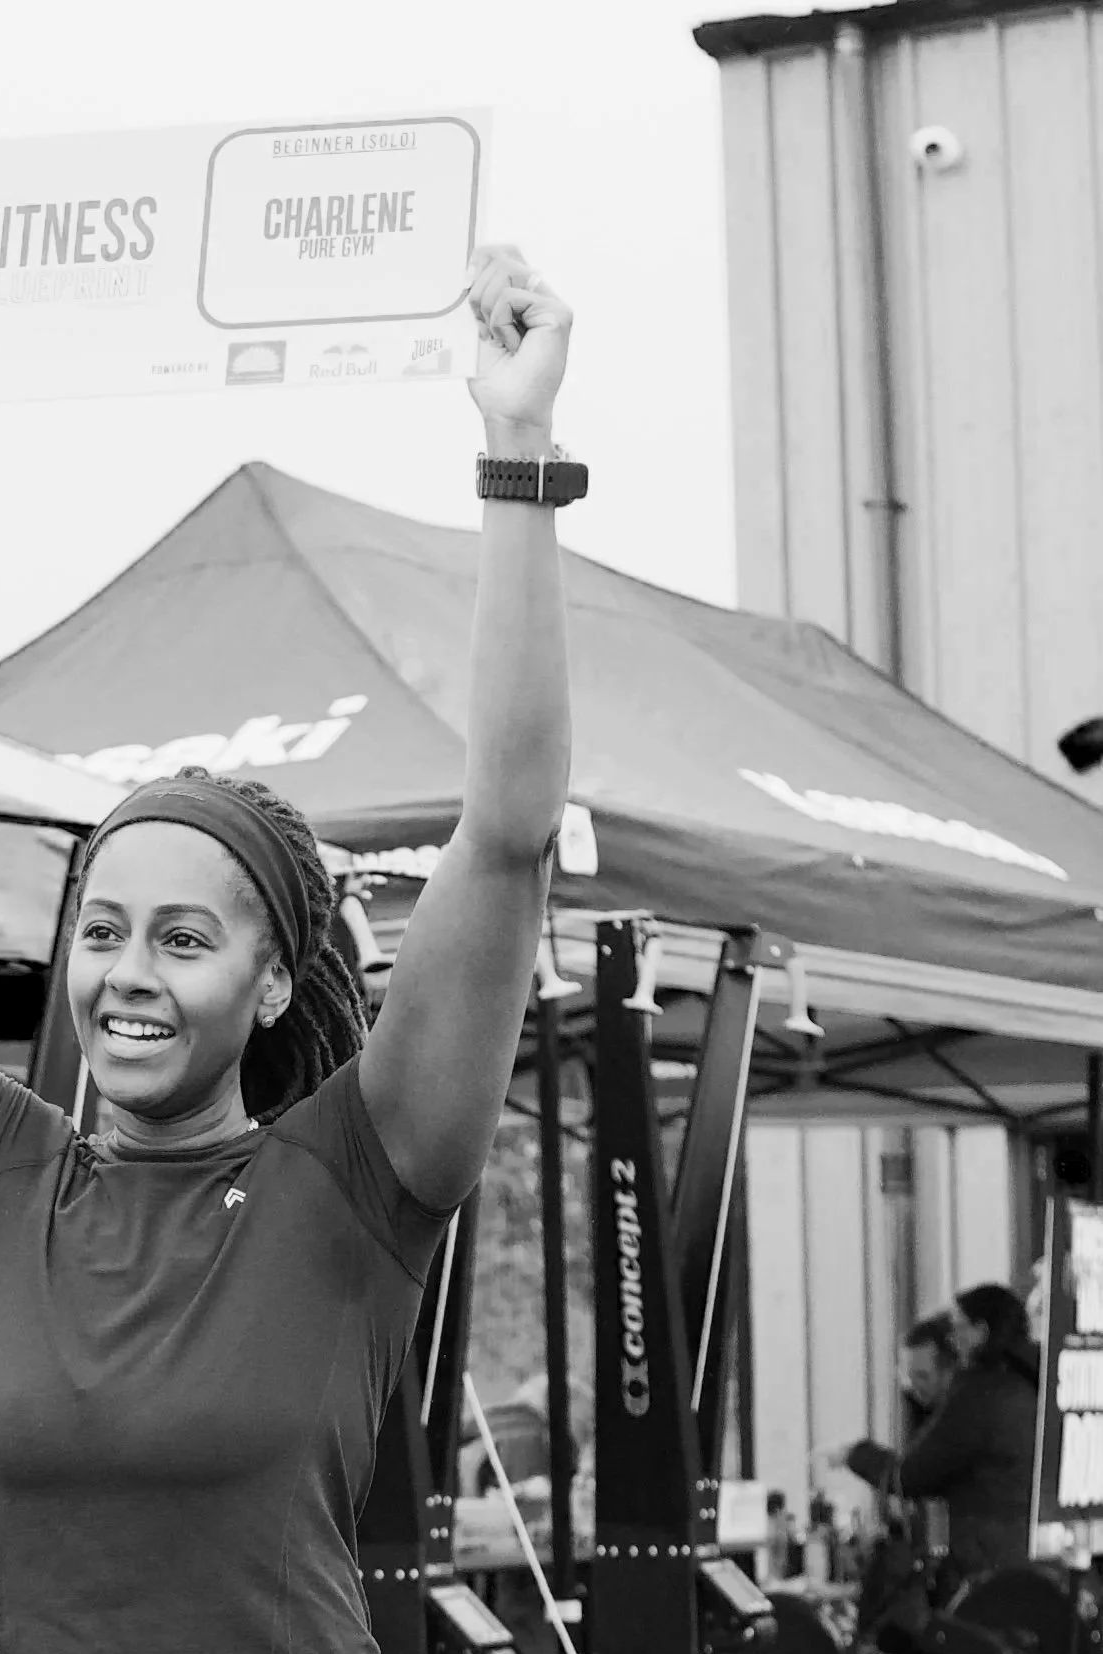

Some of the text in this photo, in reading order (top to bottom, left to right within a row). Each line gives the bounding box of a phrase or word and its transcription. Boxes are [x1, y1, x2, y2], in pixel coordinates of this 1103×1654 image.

[272, 135, 354, 155] BEGINNER
[263, 190, 416, 240] CHARLENE
[298, 235, 375, 260] PURE GYM
[308, 359, 378, 379] Red Bull
[609, 1156, 637, 1186] 2
